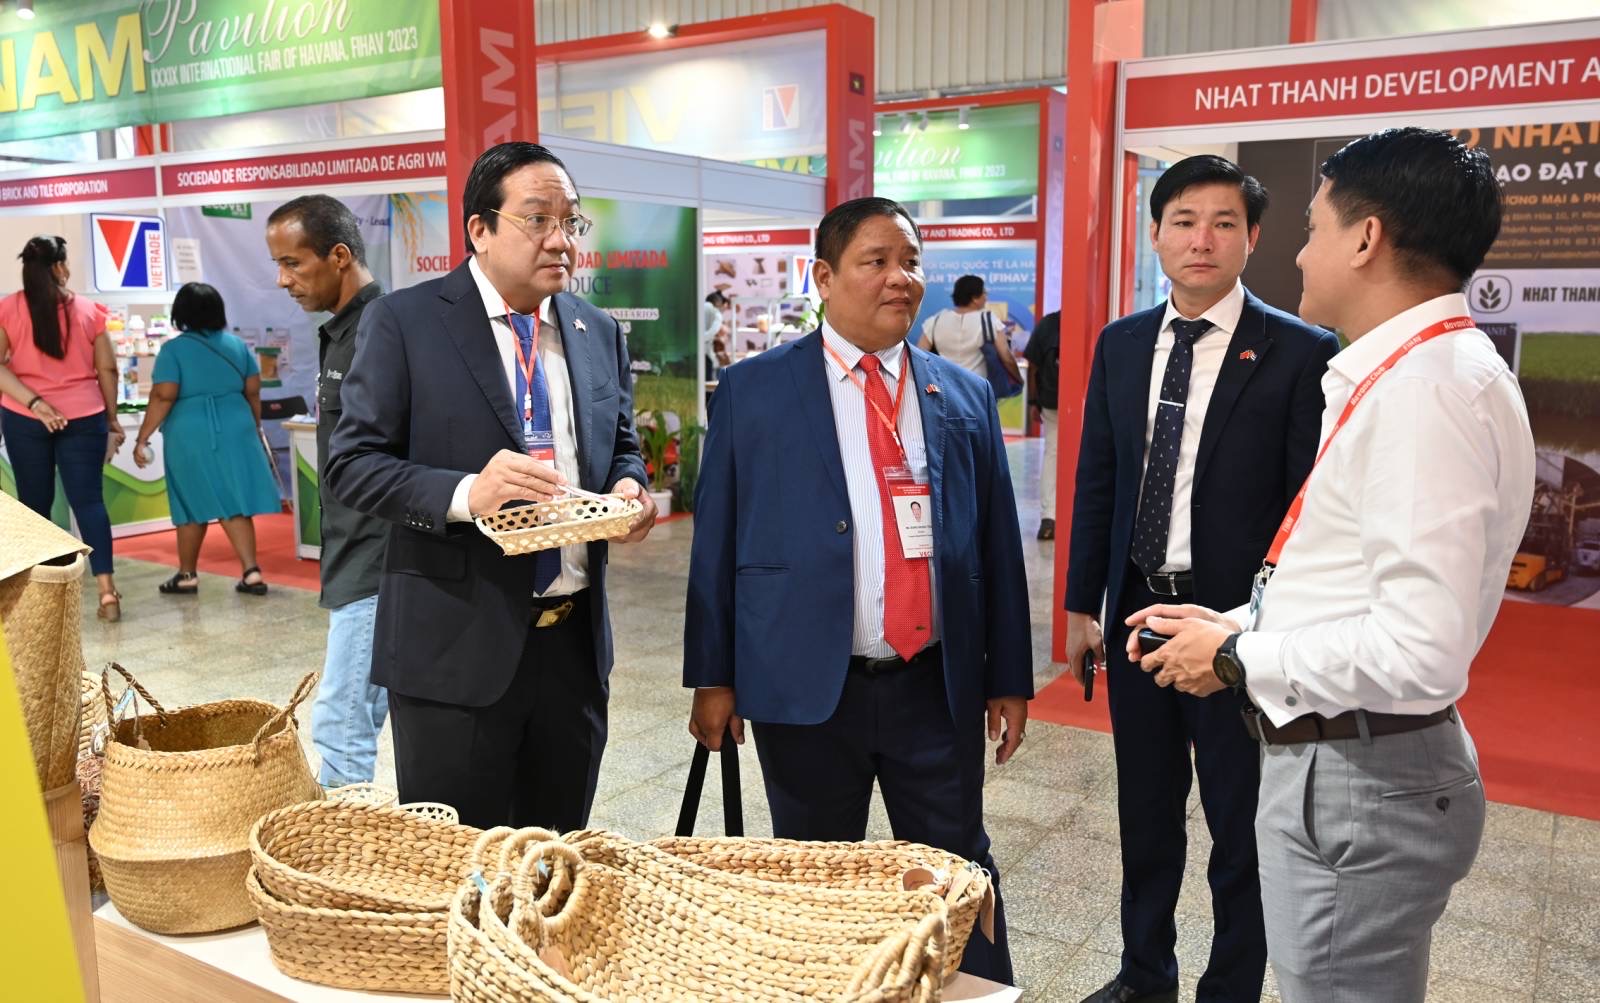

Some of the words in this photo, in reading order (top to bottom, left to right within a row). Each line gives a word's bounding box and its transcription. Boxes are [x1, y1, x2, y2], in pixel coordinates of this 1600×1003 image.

[179, 54, 257, 84] INTERNATIONAL
[258, 51, 281, 73] FAIR
[284, 48, 298, 68] OF
[351, 32, 384, 58] FIHAV
[386, 26, 418, 53] 2023
[1195, 83, 1263, 111] NHAT
[1268, 75, 1357, 106] THANH
[1364, 58, 1576, 99] DEVELOPMENT
[177, 170, 220, 188] SOCIEDAD
[222, 171, 235, 185] DE
[236, 160, 326, 183] RESPONSABILIDAD
[327, 157, 378, 176] LIMITADA
[381, 157, 395, 171] DE
[397, 153, 425, 171] AGRI
[1538, 160, 1588, 185] ĐẠT
[1, 186, 22, 200] BRICK
[23, 185, 39, 199] AND
[39, 183, 54, 197] TILE
[54, 179, 108, 197] CORPORATION
[930, 228, 947, 238] AND
[947, 227, 980, 238] TRADING
[1000, 226, 1015, 237] LTD
[149, 233, 163, 288] VIETRADE
[606, 249, 668, 269] LIMITADA
[1522, 286, 1557, 302] NHAT
[1370, 366, 1386, 381] Club
